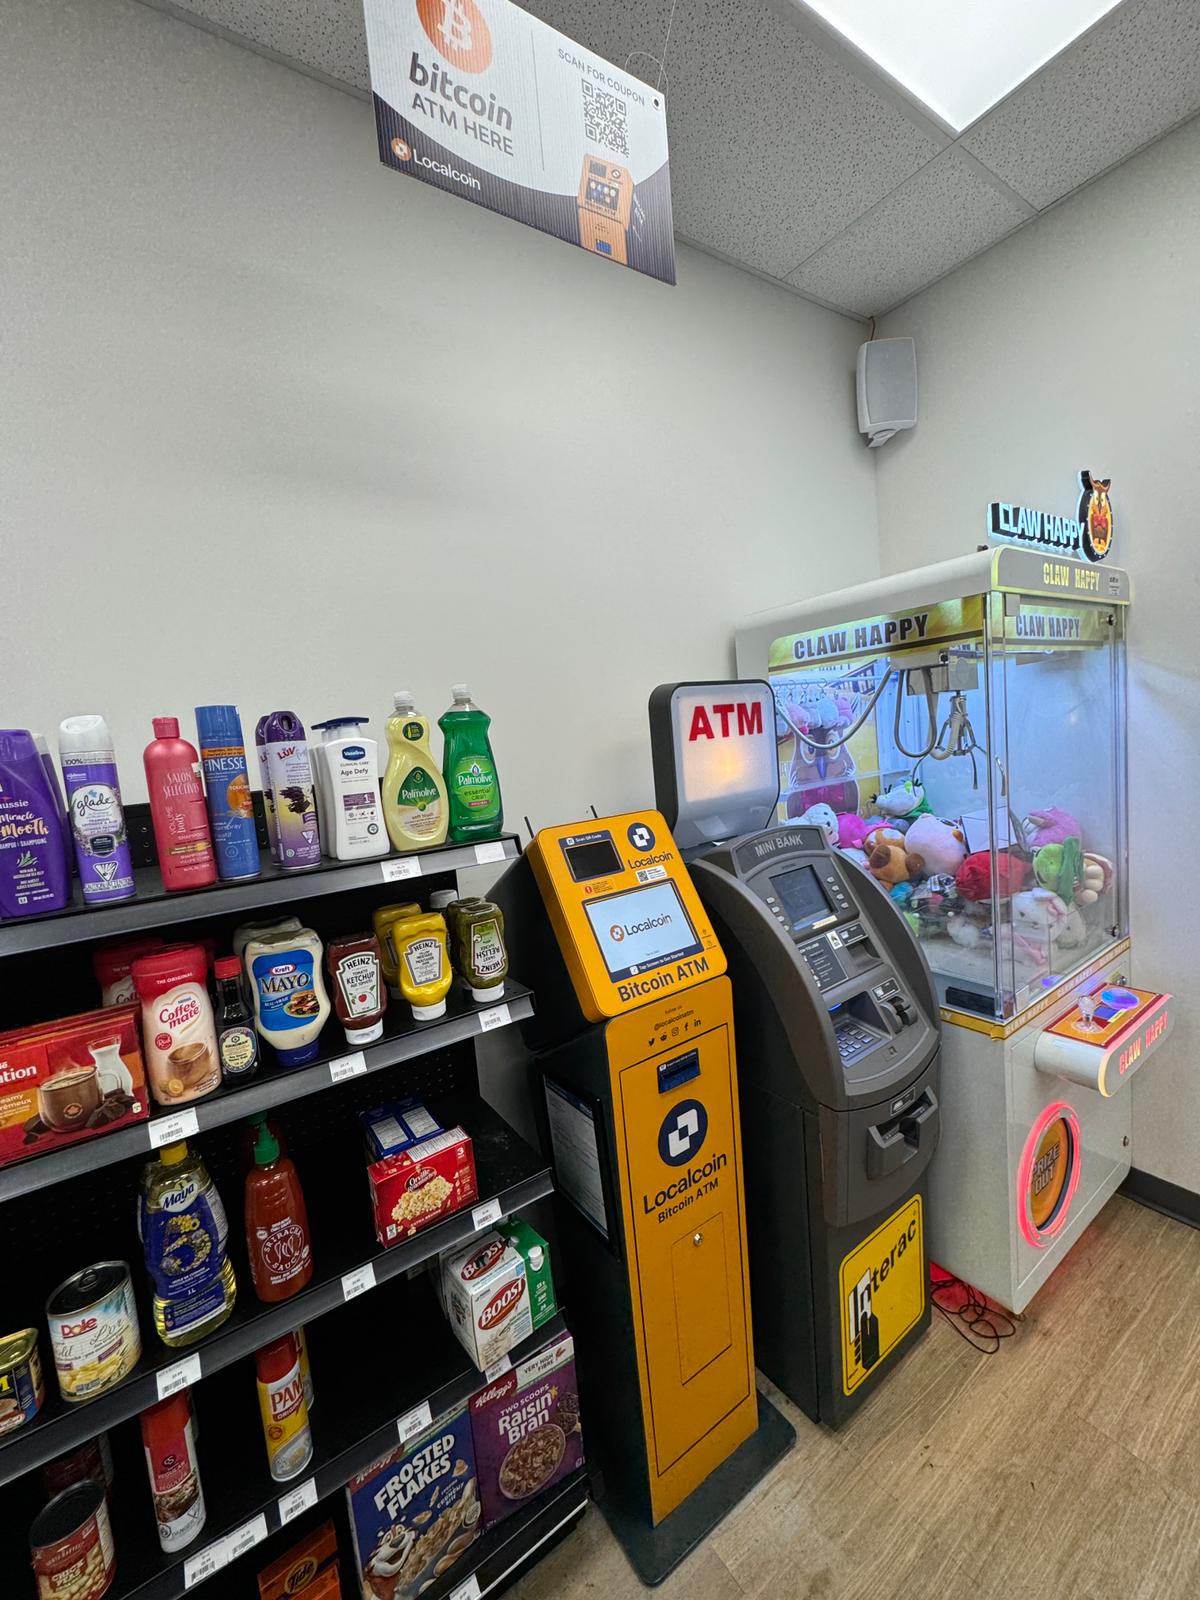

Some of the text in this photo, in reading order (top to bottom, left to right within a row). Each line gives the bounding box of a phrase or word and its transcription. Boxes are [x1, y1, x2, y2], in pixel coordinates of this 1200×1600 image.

[558, 48, 646, 107] SCAN FOR COUPON
[409, 51, 513, 131] bitcoin
[411, 92, 514, 157] ATM HERE
[413, 148, 481, 191] Localcoin
[1000, 502, 1085, 546] CLAW HAPPY
[1043, 562, 1070, 587] CLAW
[1075, 568, 1100, 592] HAPPY
[793, 613, 929, 661] CLAW HAPPY
[1016, 615, 1080, 639] CLAW HAPPY
[688, 701, 763, 742] ATM
[204, 757, 245, 772] FINESSE
[340, 767, 369, 777] Age Defy
[167, 771, 193, 785] SALON
[458, 774, 493, 786] Palmolive
[363, 793, 370, 803] 1
[402, 787, 437, 800] Palmolive
[464, 788, 490, 796] essential
[77, 793, 115, 817] glade
[754, 834, 804, 857] MINI BANK
[628, 851, 674, 869] Localcoin
[624, 913, 673, 936] Localcoin
[413, 942, 434, 952] HEINZ
[476, 946, 500, 959] RELISH
[275, 965, 291, 973] Kraft
[346, 957, 371, 970] HEINZ
[480, 960, 501, 972] HEINZ
[167, 973, 193, 984] ORIGINAL
[261, 972, 311, 994] MAYO
[346, 971, 375, 985] KETCHUP
[617, 956, 710, 1002] Bitcoin ATM
[159, 1000, 197, 1024] Coffee
[169, 1005, 200, 1029] mate
[1119, 1010, 1169, 1075] CLAW HAPPY
[0, 1098, 32, 1111] rémeux
[456, 1147, 464, 1156] 3
[1033, 1143, 1060, 1175] PRIZE
[643, 1152, 728, 1215] Localcoin
[1035, 1163, 1055, 1193] OUT
[163, 1183, 195, 1208] Maya
[658, 1178, 719, 1224] Bitcoin ATM
[263, 1226, 303, 1253] SRIRACHA
[272, 1251, 300, 1272] SAUCE
[481, 1273, 524, 1328] BOOST
[61, 1317, 98, 1337] Dole
[523, 1353, 554, 1374] VERY HIGH
[271, 1373, 303, 1412] PAM
[475, 1380, 513, 1408] Kellogg's
[500, 1384, 550, 1417] TWO SCOOPS
[498, 1391, 552, 1436] Raisin
[507, 1409, 550, 1445] Bran
[373, 1434, 456, 1512] FROSTED
[386, 1454, 452, 1520] FLAKES
[288, 1561, 314, 1593] Tide
